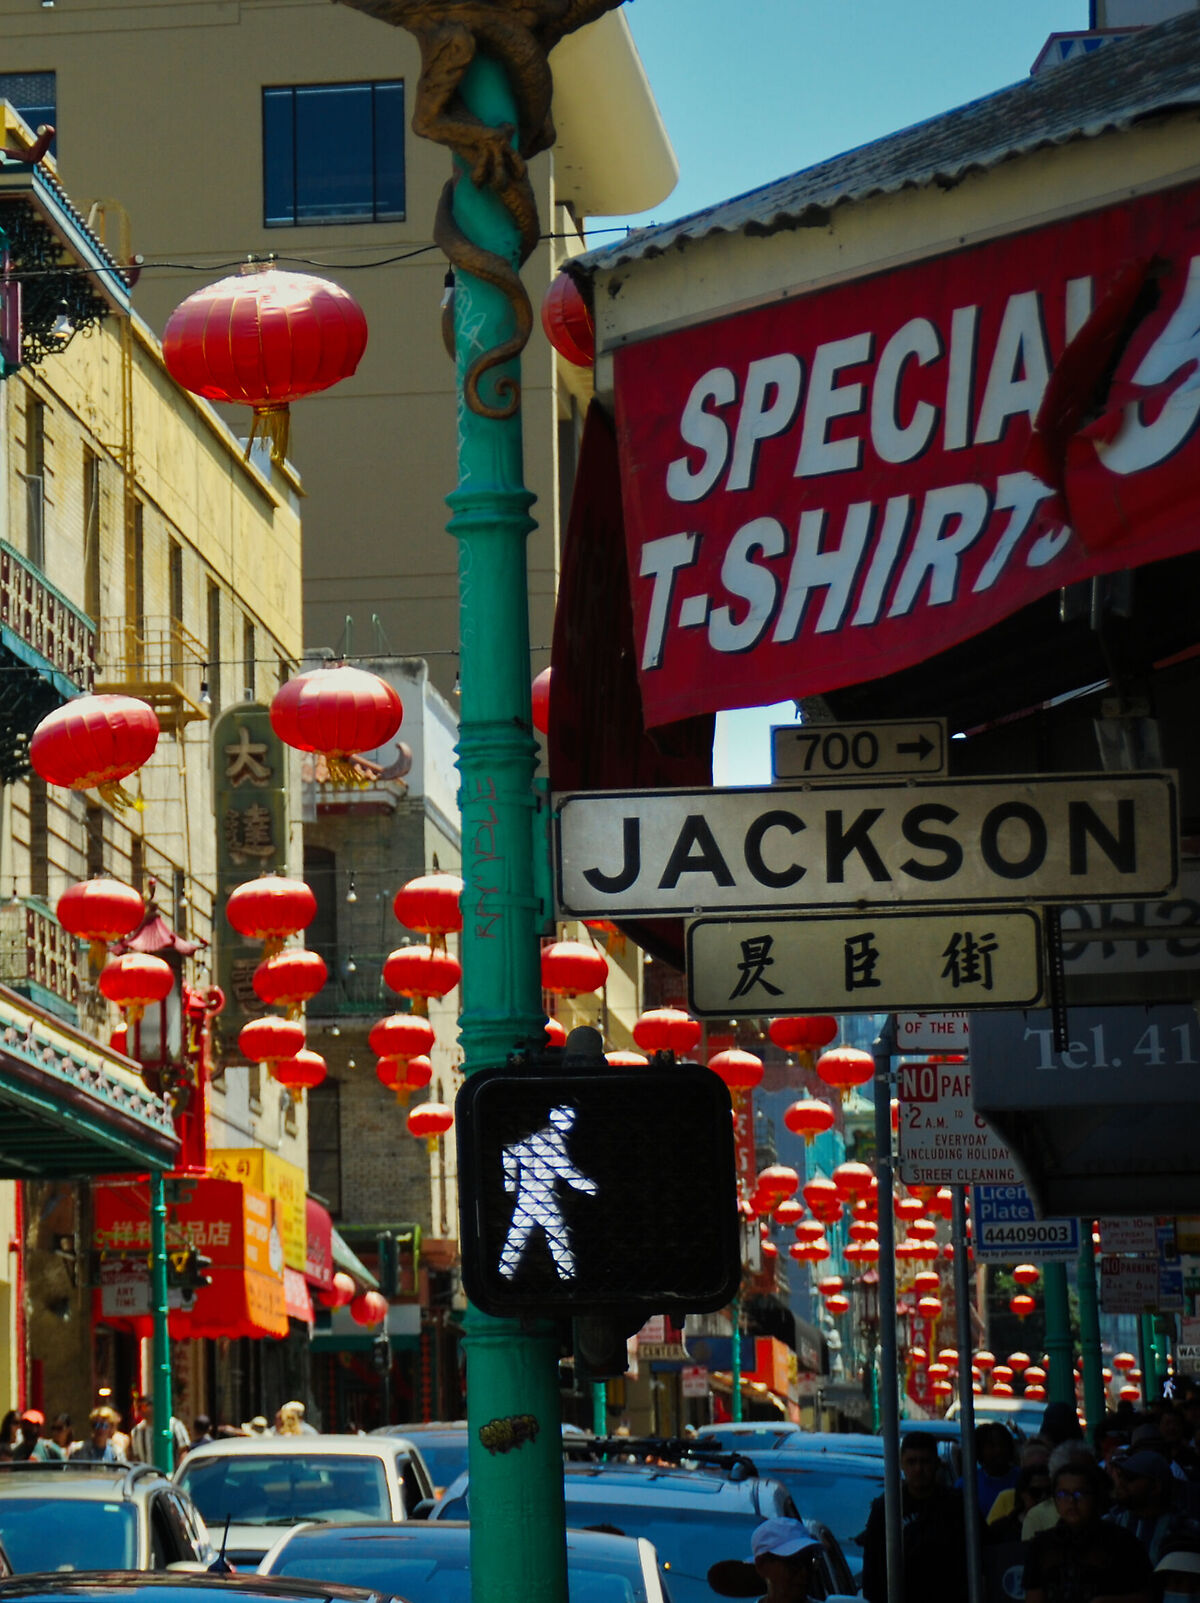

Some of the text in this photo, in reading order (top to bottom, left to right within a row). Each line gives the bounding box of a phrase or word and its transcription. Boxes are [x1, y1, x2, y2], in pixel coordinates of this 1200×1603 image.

[795, 731, 879, 772] 700
[583, 799, 1137, 894] JACKSON
[905, 1023, 921, 1033] OF
[930, 1023, 955, 1033] THE
[1024, 1023, 1200, 1070] Tel. 41
[903, 1068, 934, 1098] NO
[909, 1107, 921, 1129] 2
[926, 1118, 949, 1129] A.M.
[935, 1134, 988, 1146] EVERYDAY
[907, 1149, 1011, 1160] INCLUDING HOLIDAY
[913, 1169, 1015, 1181] STREET CLEANING
[981, 1186, 1029, 1201] Licen
[981, 1203, 1030, 1219] Plate
[985, 1227, 1068, 1242] 44409003
